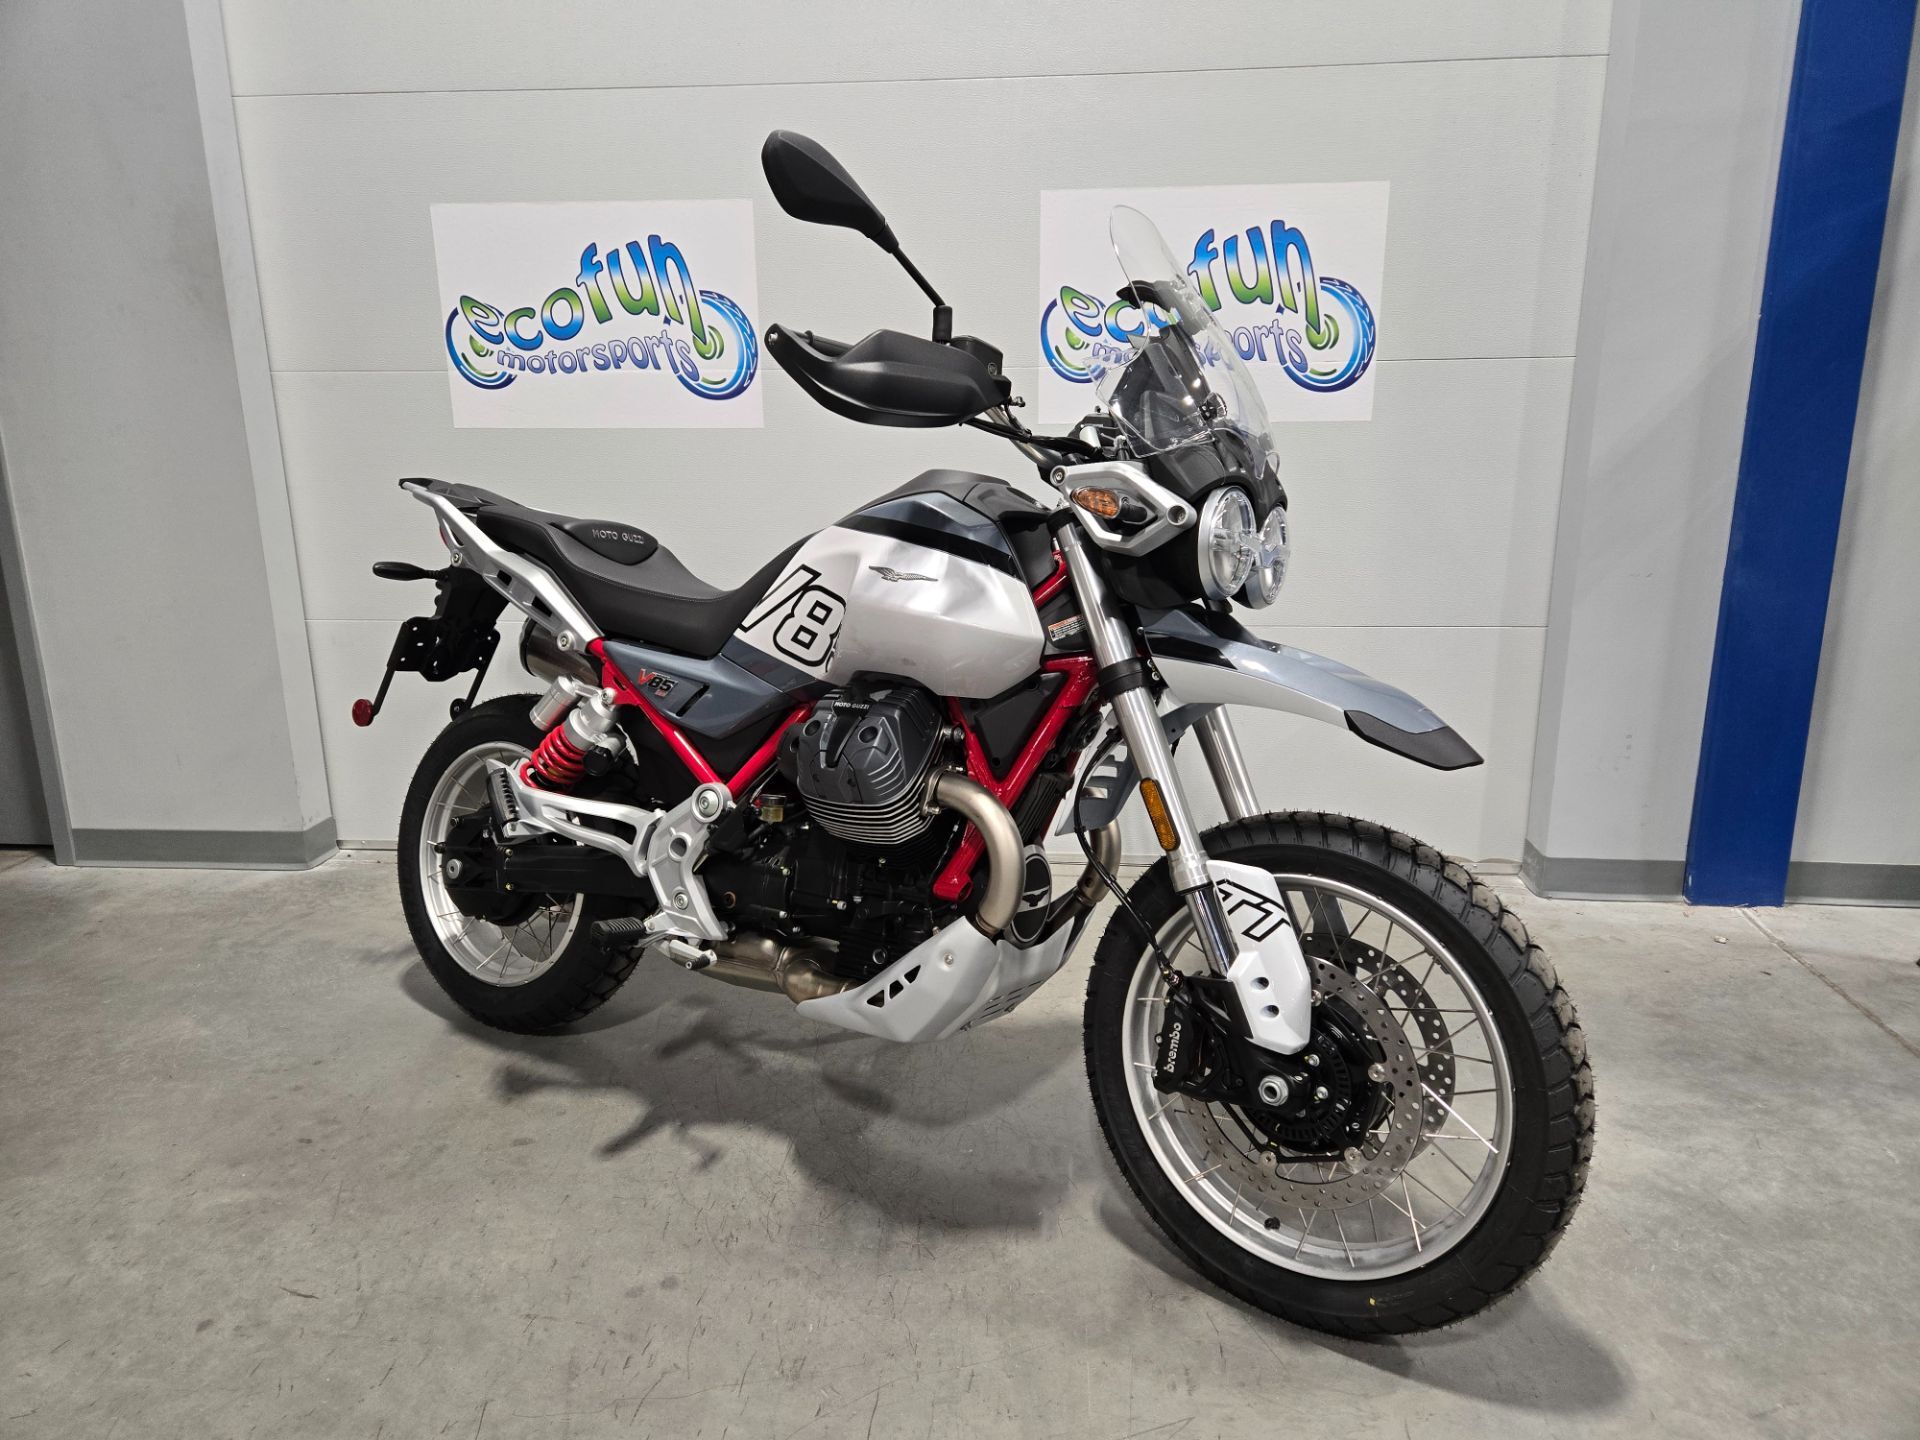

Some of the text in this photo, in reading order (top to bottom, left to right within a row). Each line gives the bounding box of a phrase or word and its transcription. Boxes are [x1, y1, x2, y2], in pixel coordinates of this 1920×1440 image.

[459, 234, 708, 345] ecofun
[496, 330, 700, 382] motorsports
[591, 529, 618, 540] MOTO
[638, 667, 677, 692] V85
[833, 701, 870, 710] MOTO GUZZI
[1163, 1021, 1183, 1074] brembo
